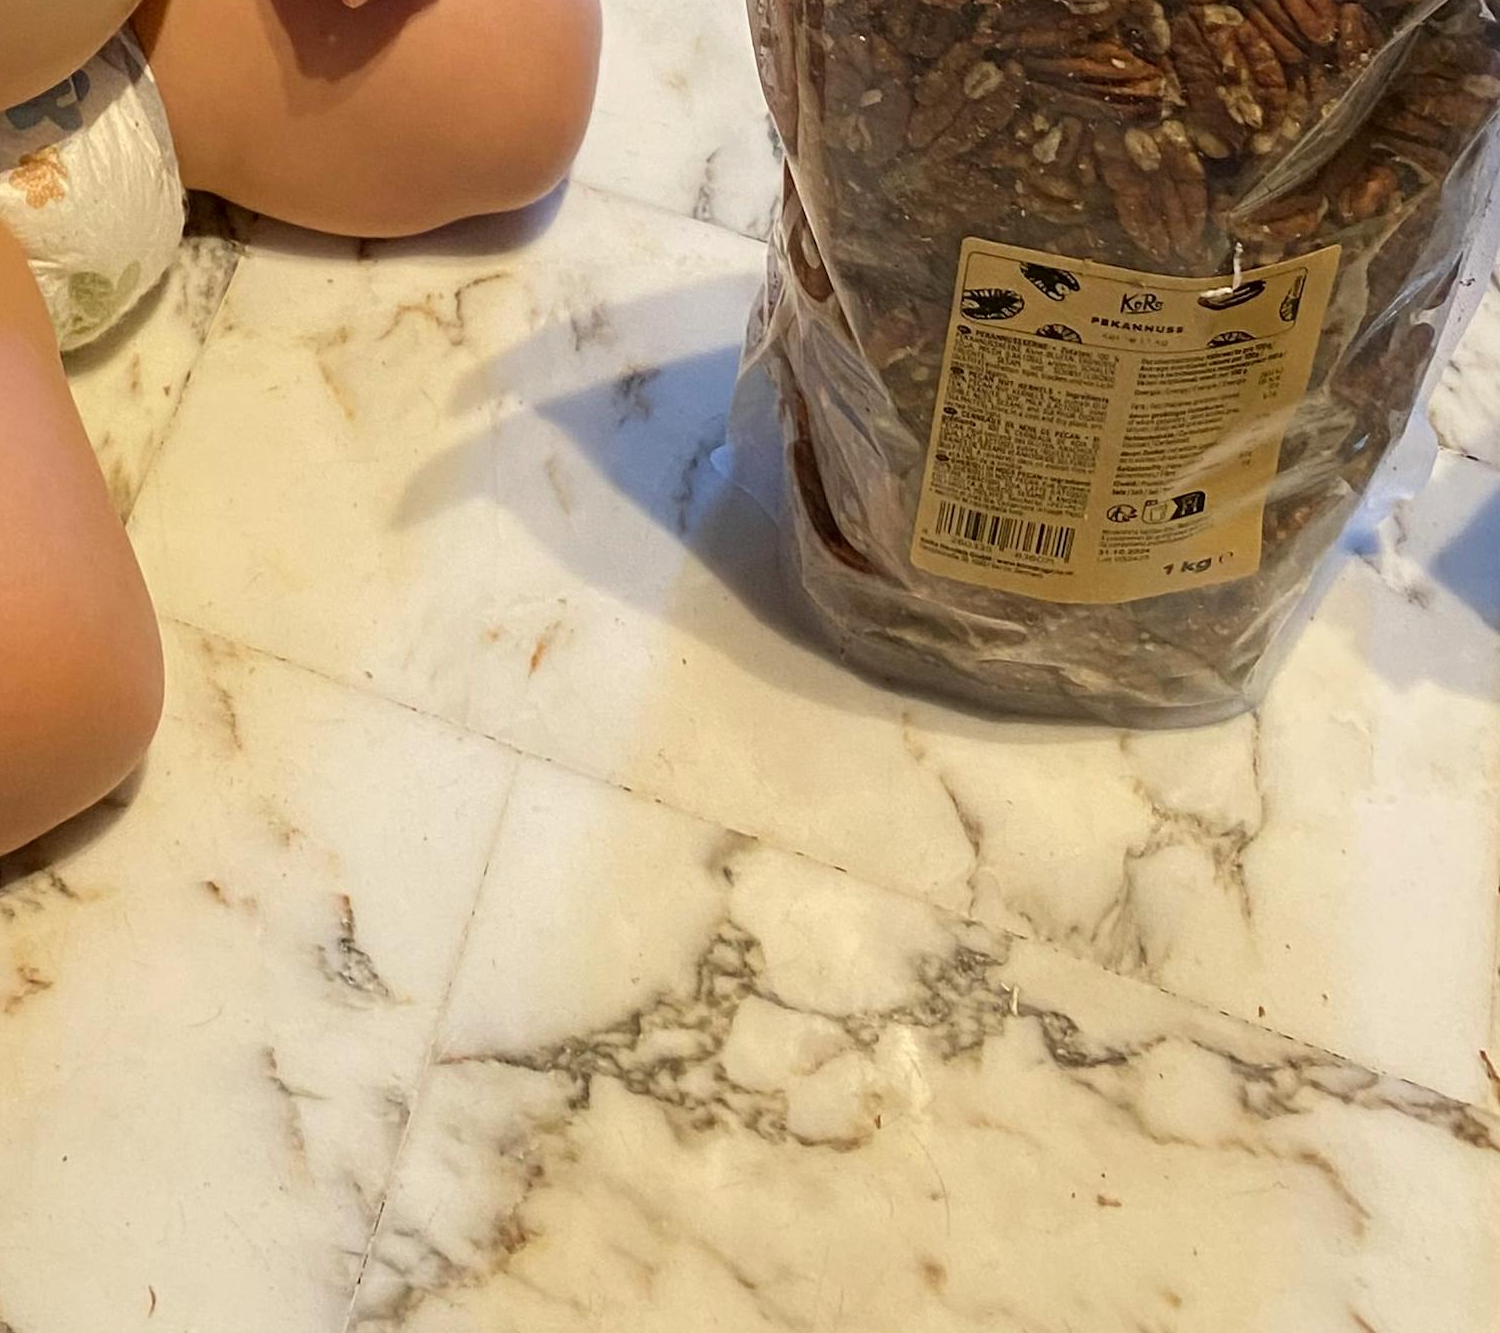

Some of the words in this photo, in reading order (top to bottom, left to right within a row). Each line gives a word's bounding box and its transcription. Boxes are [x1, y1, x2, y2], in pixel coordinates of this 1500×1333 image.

[1120, 293, 1164, 314] KoRo
[1091, 316, 1184, 334] PEKANNUSS
[1163, 563, 1174, 575] 1
[1181, 557, 1212, 573] kg
